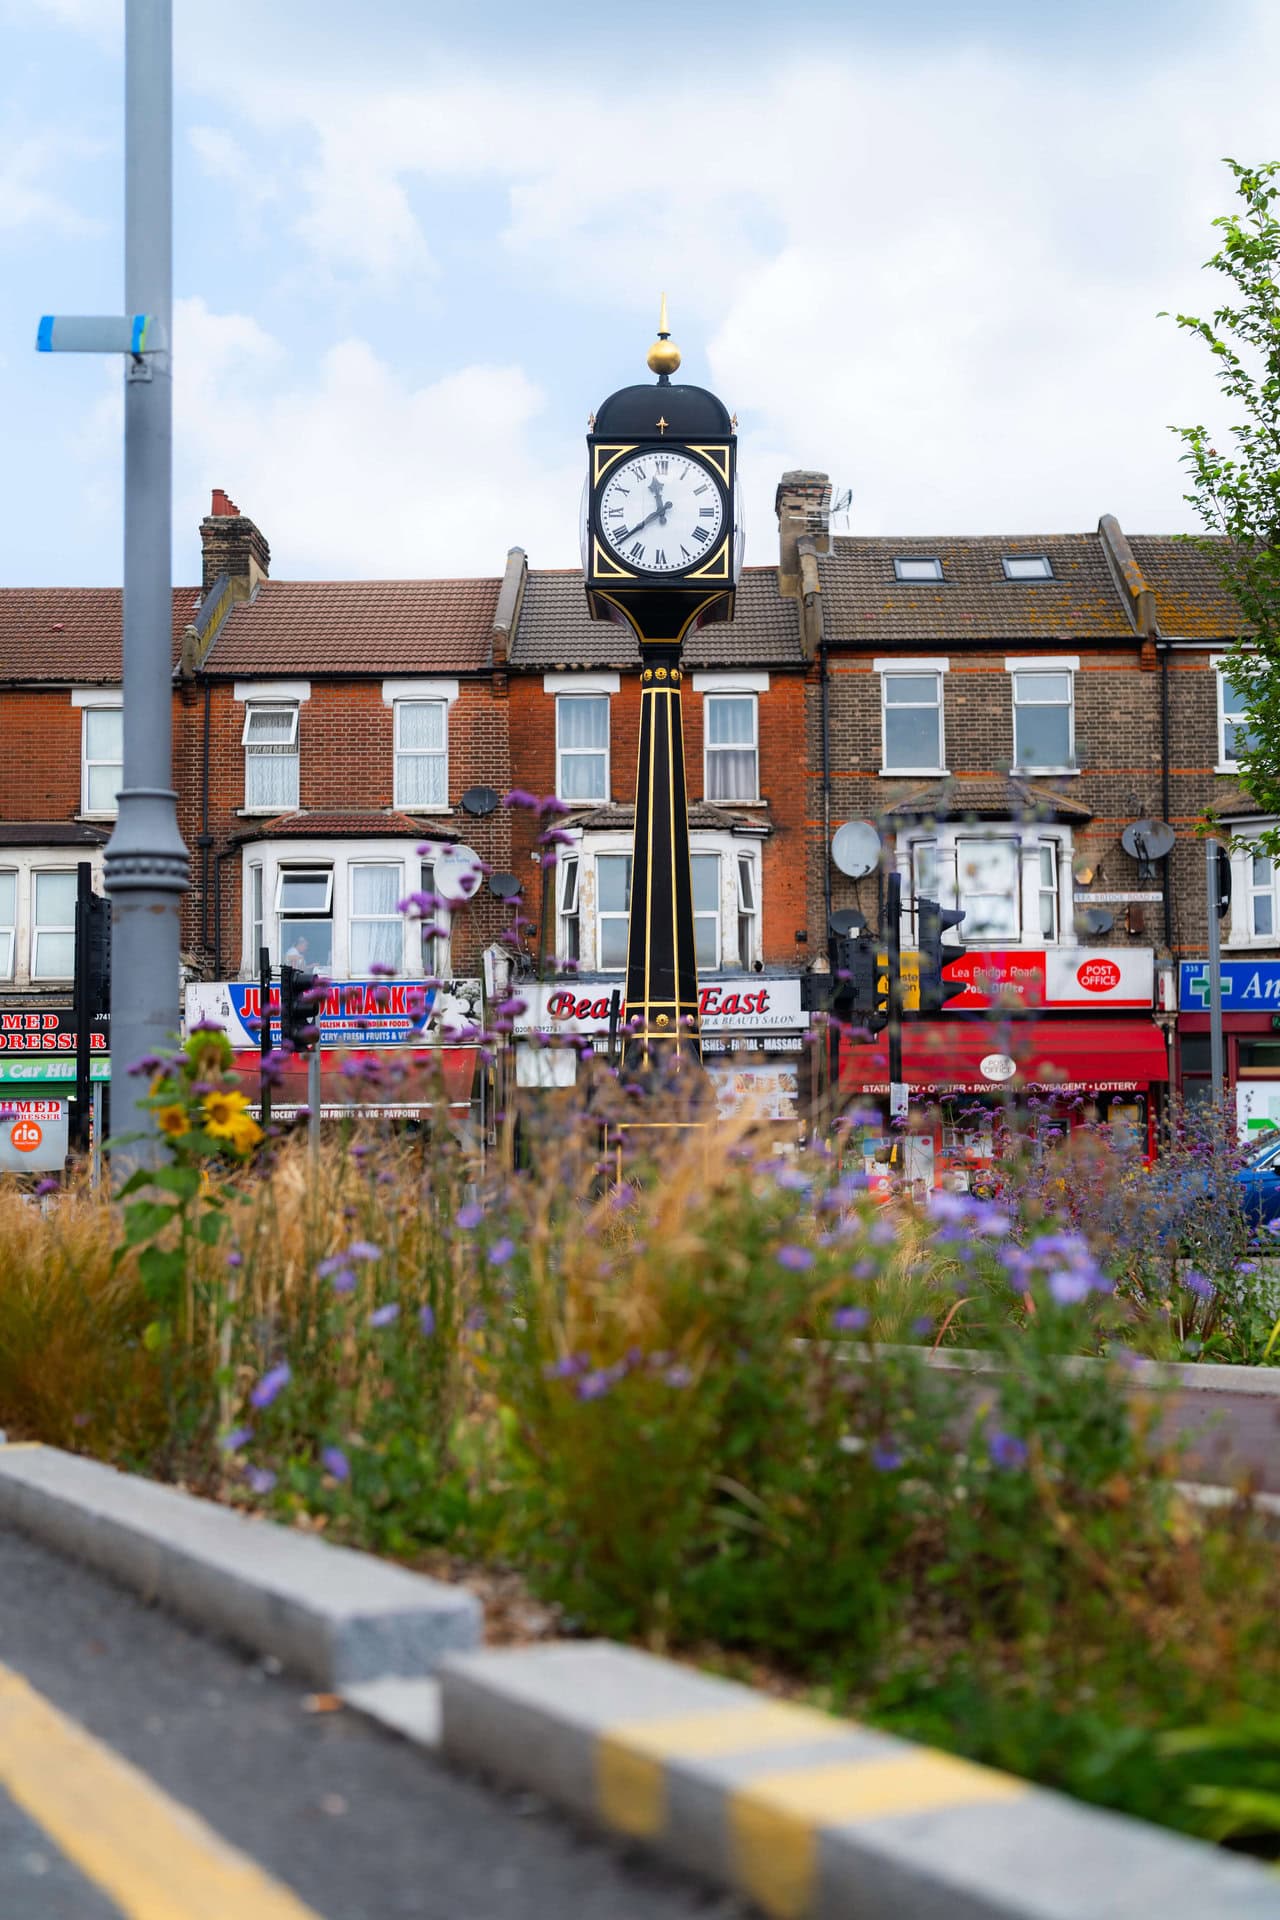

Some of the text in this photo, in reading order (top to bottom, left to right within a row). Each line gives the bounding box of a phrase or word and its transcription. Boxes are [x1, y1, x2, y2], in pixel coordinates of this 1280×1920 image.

[655, 460, 669, 475] XII
[631, 465, 647, 483] XI
[614, 483, 630, 497] X
[693, 483, 709, 496] II
[699, 507, 715, 518] III
[951, 966, 1037, 980] Lea Bridge Road
[1086, 965, 1112, 975] POST
[1081, 976, 1116, 985] OFFICE
[991, 983, 1024, 993] Office
[1240, 971, 1280, 1004] An
[698, 987, 769, 1016] East
[721, 1016, 760, 1025] BEAUTY
[761, 1015, 796, 1024] SALON
[343, 1033, 365, 1041] FRESH
[366, 1032, 391, 1041] FRUITS
[764, 1039, 803, 1050] MASSAGE
[10, 1064, 42, 1079] Car
[45, 1063, 77, 1078] Hir
[1094, 1082, 1138, 1091] LOTTERY
[365, 1110, 379, 1118] VEG
[384, 1109, 420, 1119] PAYPOINT
[14, 1123, 39, 1141] ria
